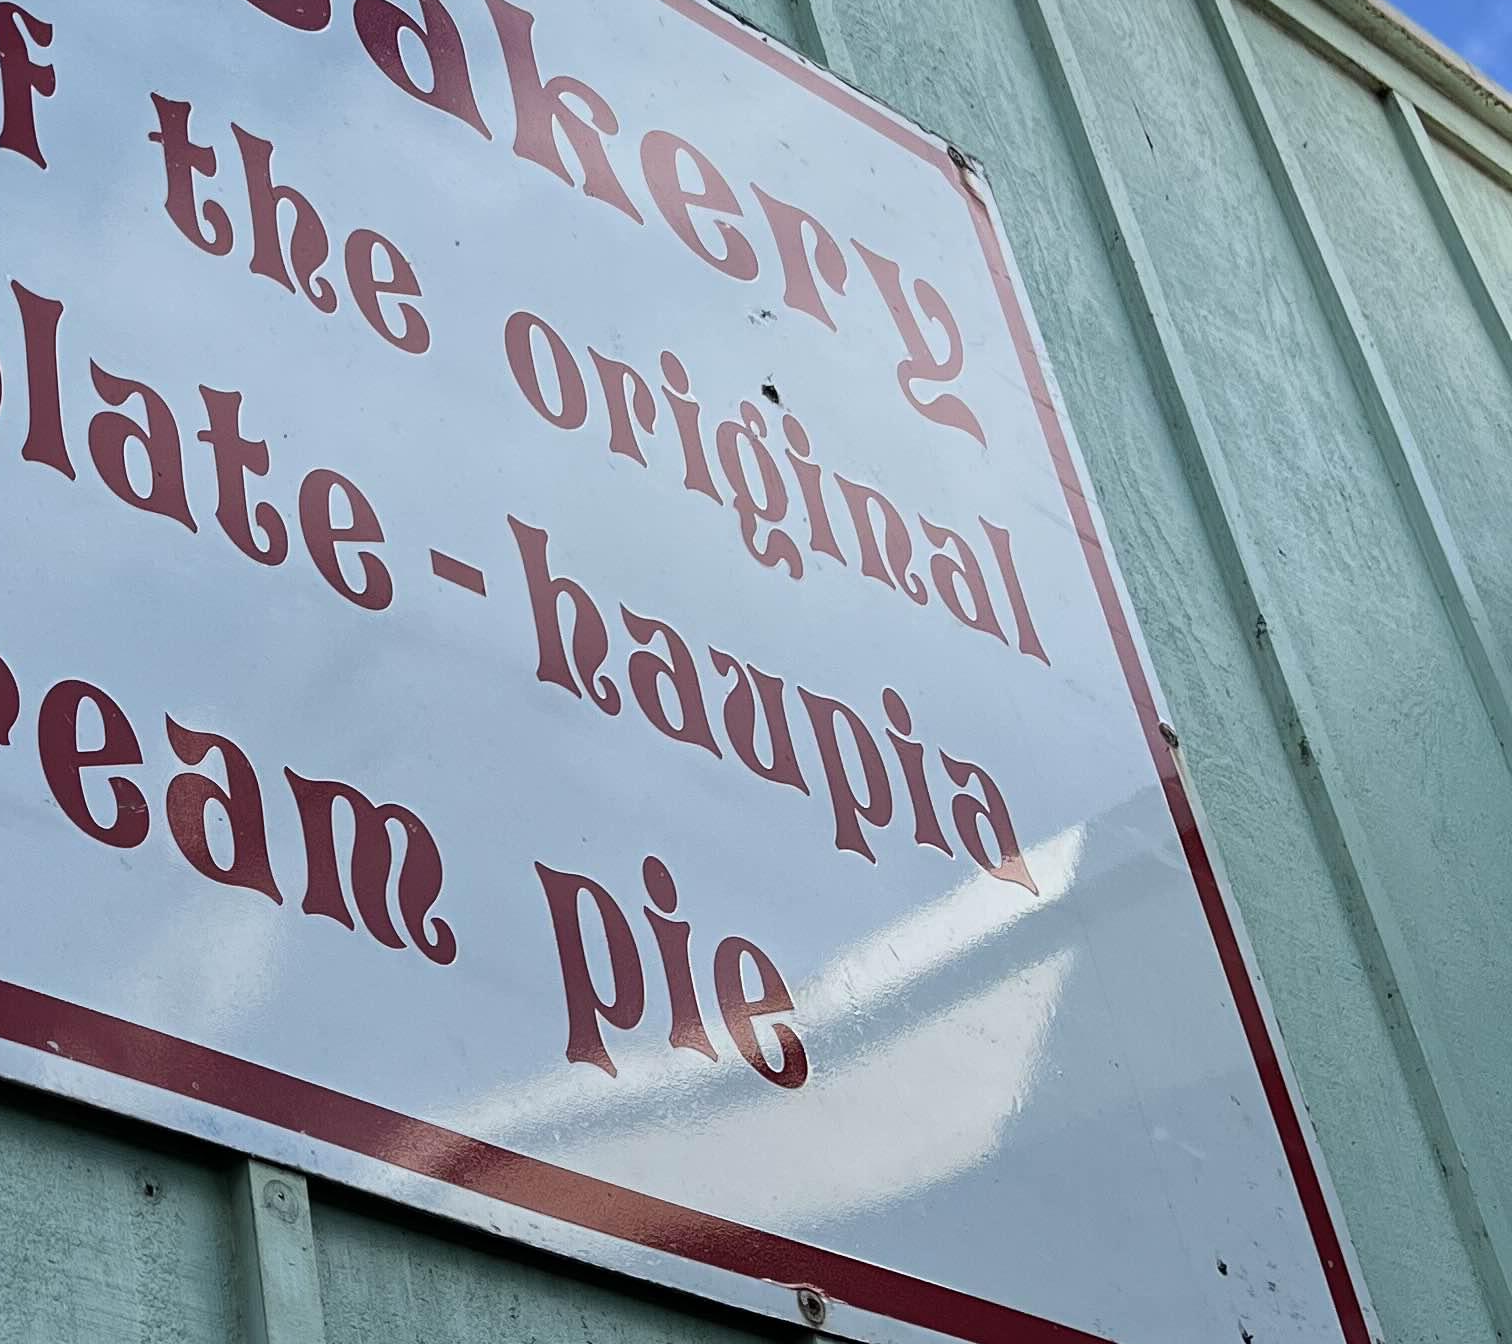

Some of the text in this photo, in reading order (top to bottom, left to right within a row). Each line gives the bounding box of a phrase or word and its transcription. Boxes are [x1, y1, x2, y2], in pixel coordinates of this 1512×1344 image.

[147, 92, 430, 355] the
[503, 310, 1051, 666] original
[536, 855, 808, 1089] pie
